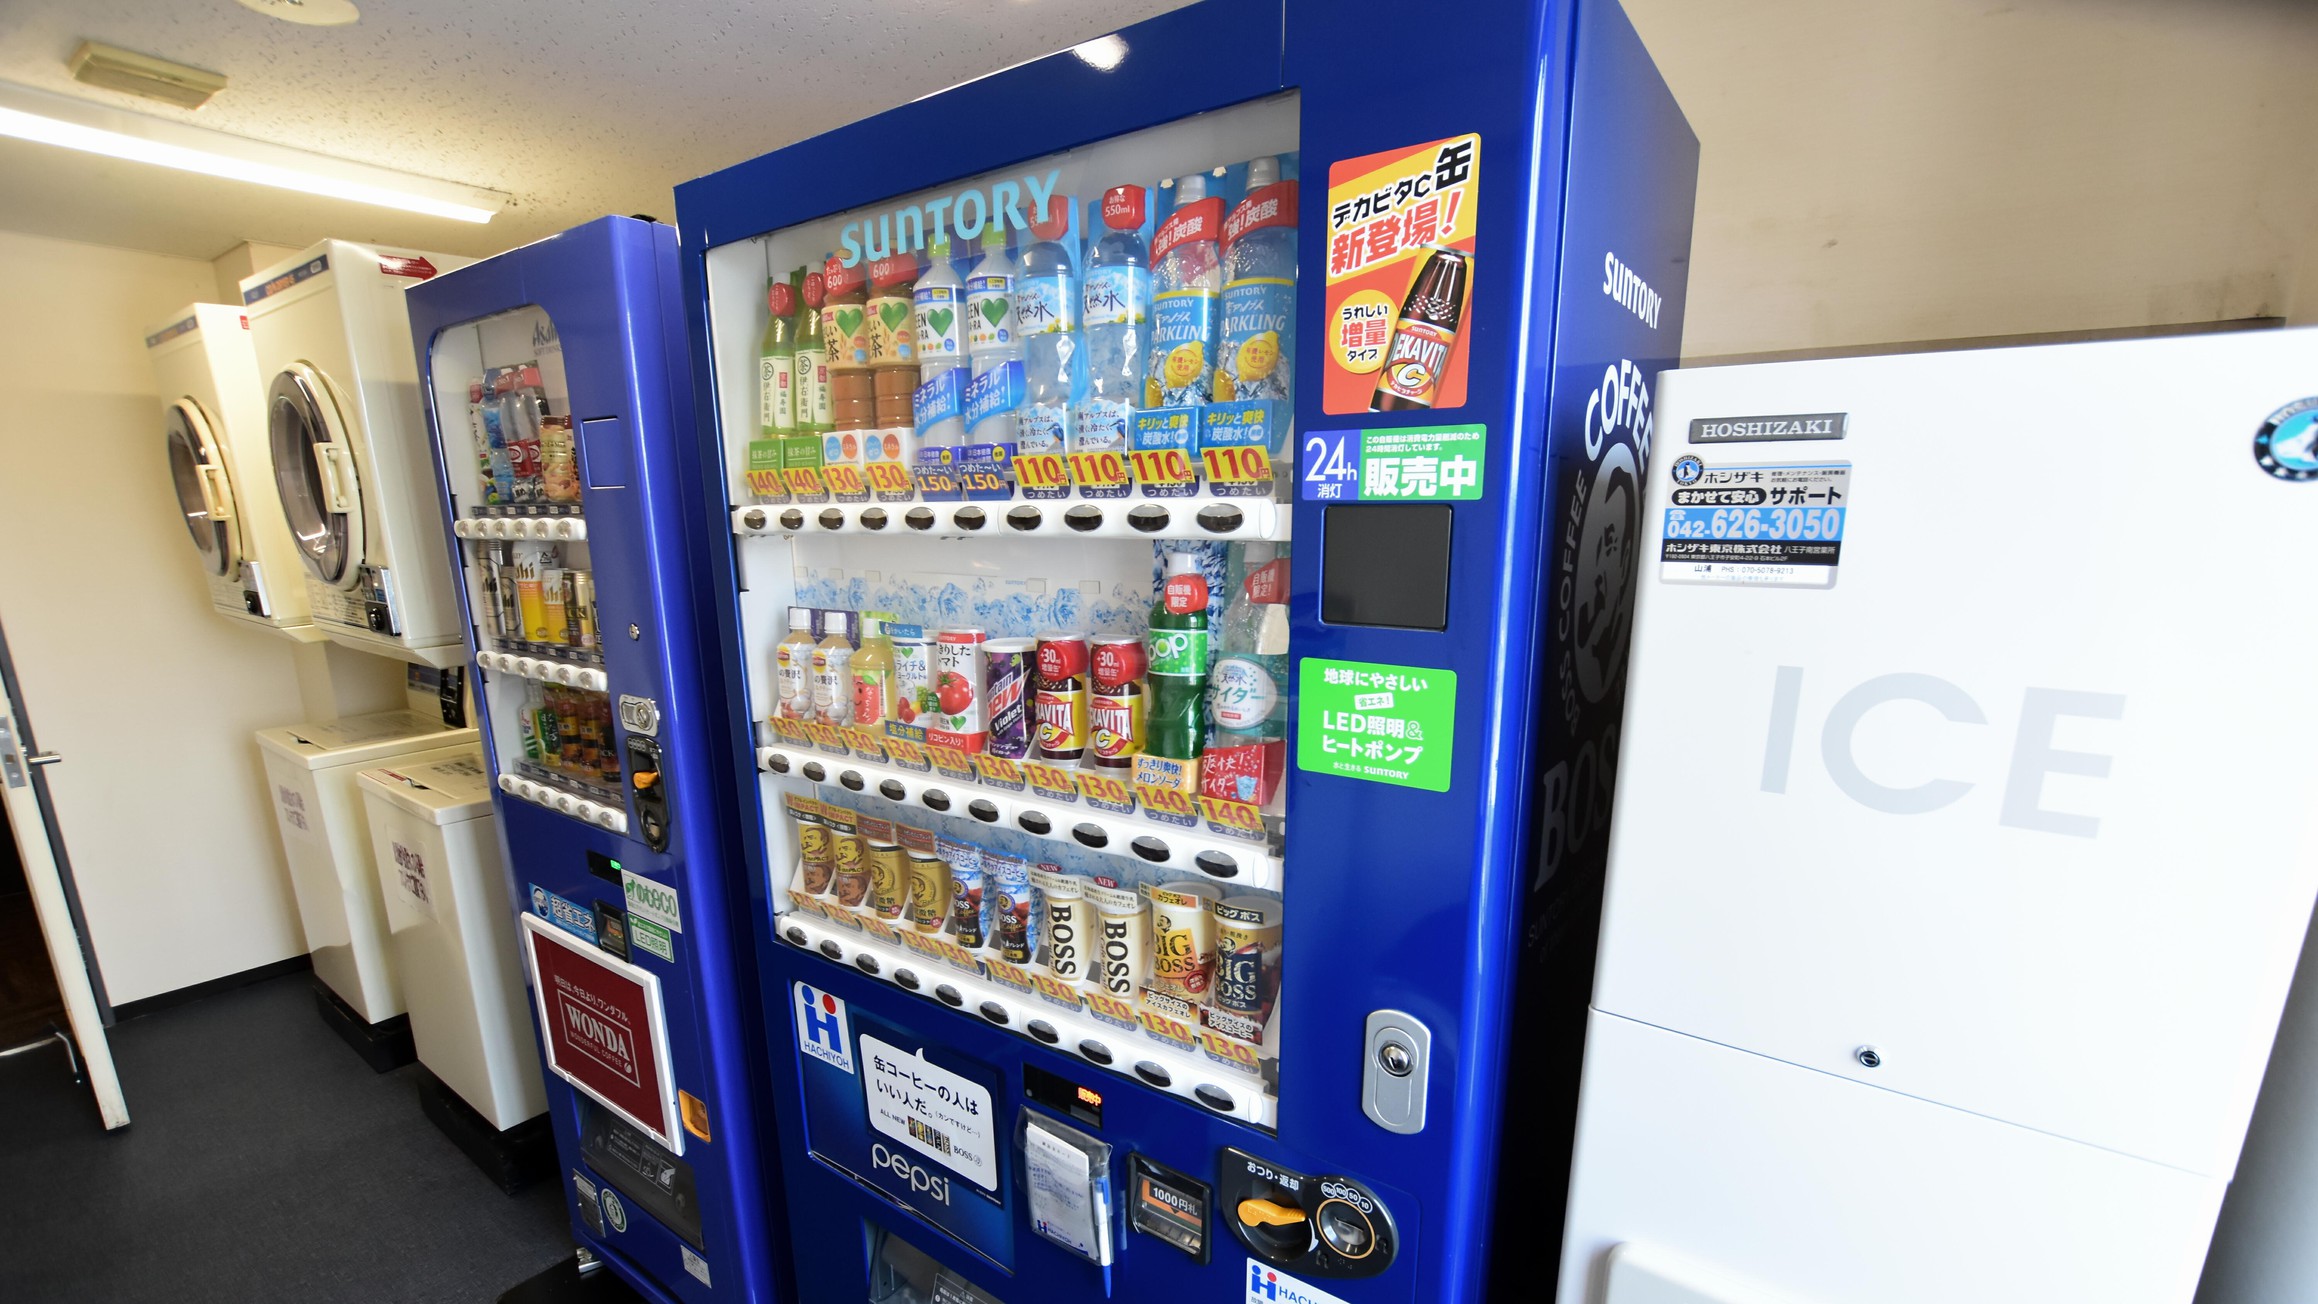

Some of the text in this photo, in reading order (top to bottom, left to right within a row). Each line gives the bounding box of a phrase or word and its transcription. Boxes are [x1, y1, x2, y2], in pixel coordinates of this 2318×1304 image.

[841, 170, 1060, 269] SUNTORY
[1104, 204, 1131, 217] 550ml
[1330, 191, 1462, 275] 新登場!
[873, 262, 890, 279] 600
[827, 274, 843, 289] 600
[1603, 251, 1662, 330] SUNTORY
[1225, 286, 1267, 300] SUNTORY
[1342, 304, 1388, 320] うれしい
[1341, 319, 1387, 348] 増量
[1411, 325, 1438, 337] SUNTORY
[1347, 349, 1378, 362] タイプ
[914, 376, 946, 408] ミネラル
[965, 369, 1001, 402] ミネラル
[914, 393, 951, 429] 水分補給!
[965, 386, 1006, 425] 水分補給!
[1138, 414, 1189, 430] キリッと爽快
[1207, 409, 1265, 426] キリッと爽快
[1142, 430, 1175, 446] 炭酸水!
[1211, 427, 1249, 442] 炭酸水!
[1366, 432, 1480, 444] この自販機は消費電力量削減のため
[1701, 419, 1833, 438] HOSHIZAKI
[1069, 453, 1126, 484] 110円
[1130, 450, 1193, 482] 110円
[1204, 447, 1271, 481] 110円
[1304, 435, 1358, 482] 24h
[865, 463, 910, 491] 130円
[1014, 456, 1068, 485] 110円
[1364, 454, 1477, 497] 販売中
[1704, 472, 1765, 484] ホシザキ
[917, 476, 962, 492] 150円
[962, 474, 1009, 491] 150円
[1147, 487, 1194, 498] つめたい
[1216, 486, 1267, 497] つめたい
[1317, 483, 1343, 499] 消灯
[1027, 490, 1066, 499] つめたい
[1084, 489, 1127, 498] つめたい
[1677, 486, 1842, 505] まかせて安心 サポート
[1667, 508, 1840, 539] 042-626-3050
[1665, 543, 1836, 555] ホシザキ東京株式会社 八王子南営業所
[1252, 568, 1276, 584] 自販機
[1167, 584, 1192, 596] 自販機
[1170, 596, 1188, 608] 限定
[1324, 667, 1428, 692] 地球にやさしい
[1211, 684, 1266, 705] サイダー
[1358, 695, 1391, 708] 省エネ!
[994, 703, 1023, 731] Violet
[1322, 710, 1424, 741] LED照明&
[889, 723, 924, 740] 塩分補給
[1322, 735, 1424, 765] ヒートポンプ
[1760, 664, 2128, 840] ICE
[1137, 758, 1182, 776] すっきり爽快!
[1333, 761, 1409, 780] 水と生きる SUNTORY
[1023, 763, 1077, 794] 130円
[1136, 772, 1181, 788] メロンソーダ
[1077, 774, 1132, 806] 130円
[1136, 785, 1194, 814] 140円
[1150, 811, 1193, 827] つめたい
[1201, 799, 1264, 831] 140円
[1213, 825, 1260, 840] つめたい
[1040, 864, 1058, 872] NEW
[1097, 876, 1116, 888] NEW
[1157, 892, 1188, 906] カフェオレ
[1050, 904, 1077, 976] BOSS
[1103, 919, 1131, 994] BOSS
[1146, 998, 1192, 1018] アイスカフェオレ
[1147, 990, 1189, 1011] ビッグサイズの
[565, 1002, 631, 1061] WONDA
[1140, 1011, 1194, 1044] 130円
[1207, 1019, 1254, 1039] アイスコーヒー
[1208, 1011, 1254, 1032] ビッグサイズの
[1150, 1033, 1193, 1052] つめたい
[1201, 1031, 1258, 1065] 130円
[804, 1039, 850, 1070] HACHIYOH
[1210, 1054, 1255, 1074] つめたい
[873, 1054, 980, 1117] 缶コーヒーの人は
[876, 1078, 933, 1119] いい人だ。
[953, 1145, 973, 1162] BOSS
[871, 1143, 950, 1207] pepsi
[1246, 1161, 1300, 1192] おつり・返却
[1153, 1186, 1198, 1216] 1000円札
[1361, 1201, 1370, 1210] 10
